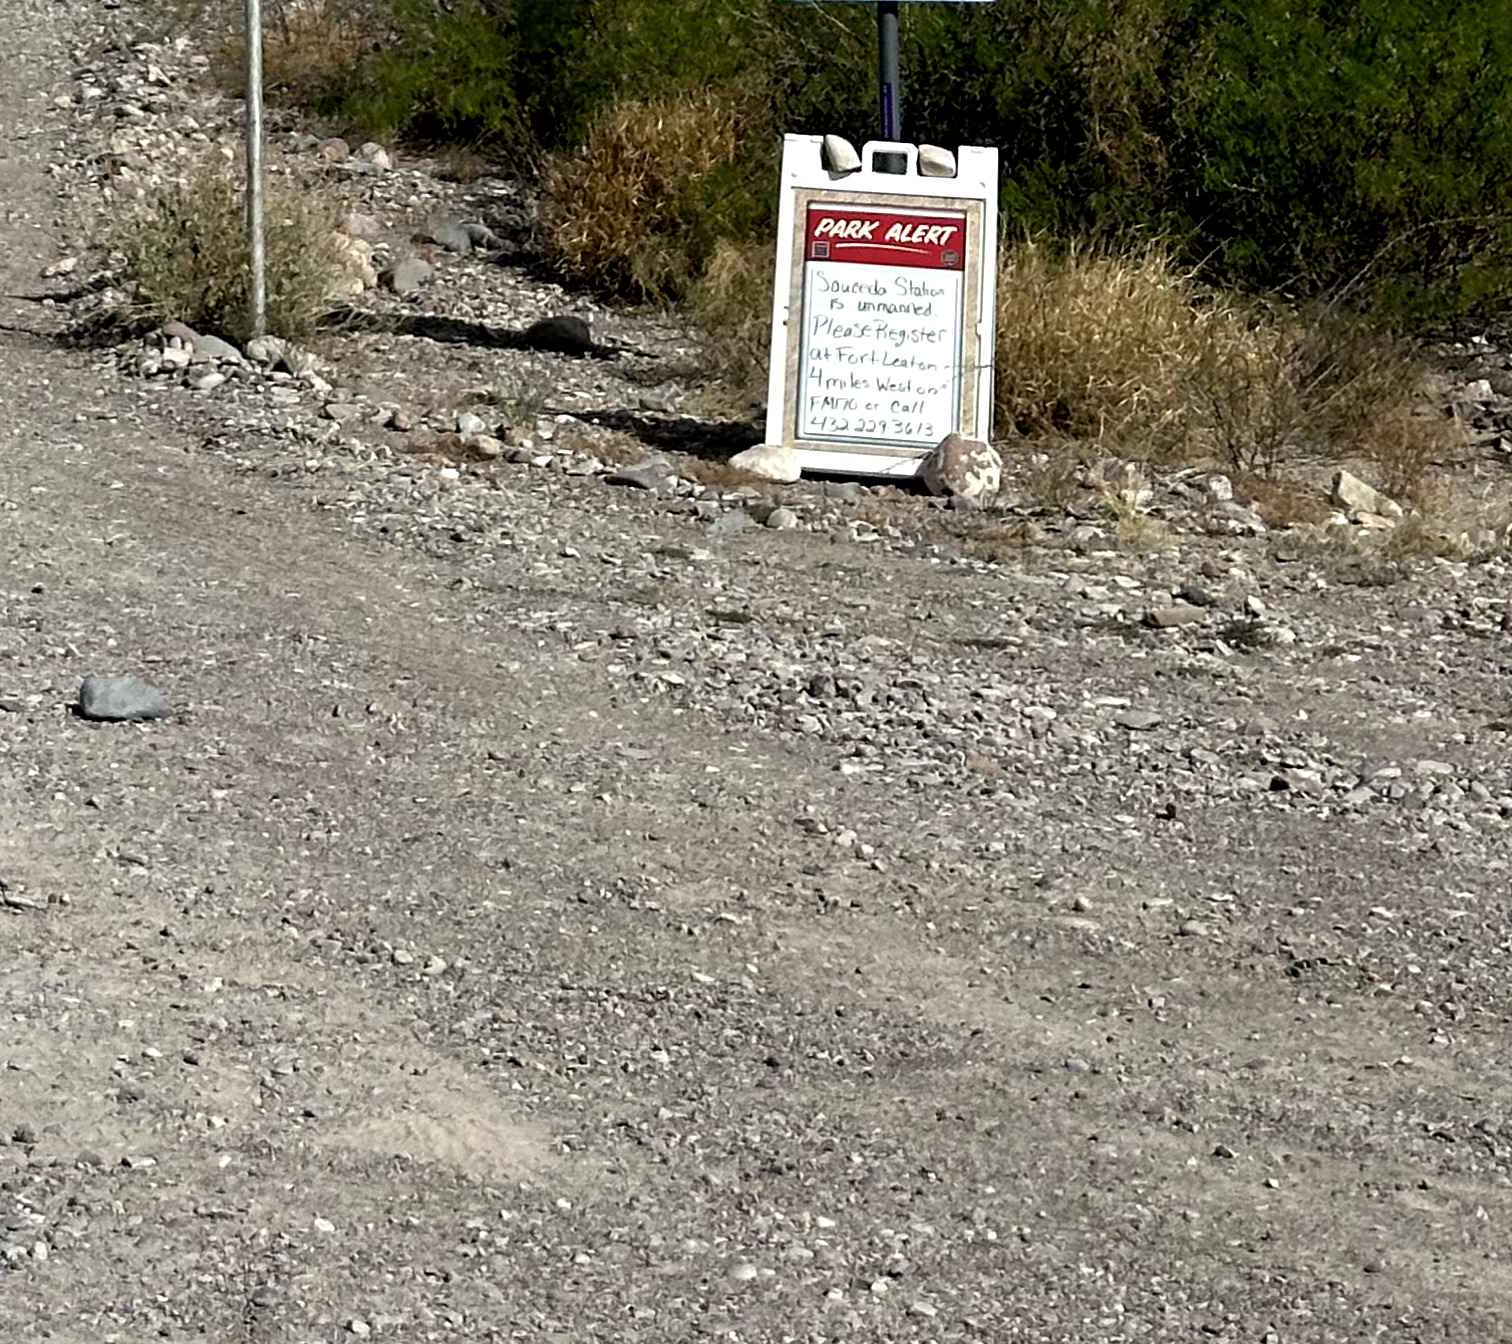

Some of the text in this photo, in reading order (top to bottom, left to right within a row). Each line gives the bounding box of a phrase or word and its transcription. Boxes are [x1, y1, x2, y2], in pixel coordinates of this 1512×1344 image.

[814, 217, 958, 246] PARK ALERT
[809, 347, 832, 361] at
[809, 365, 823, 387] 4
